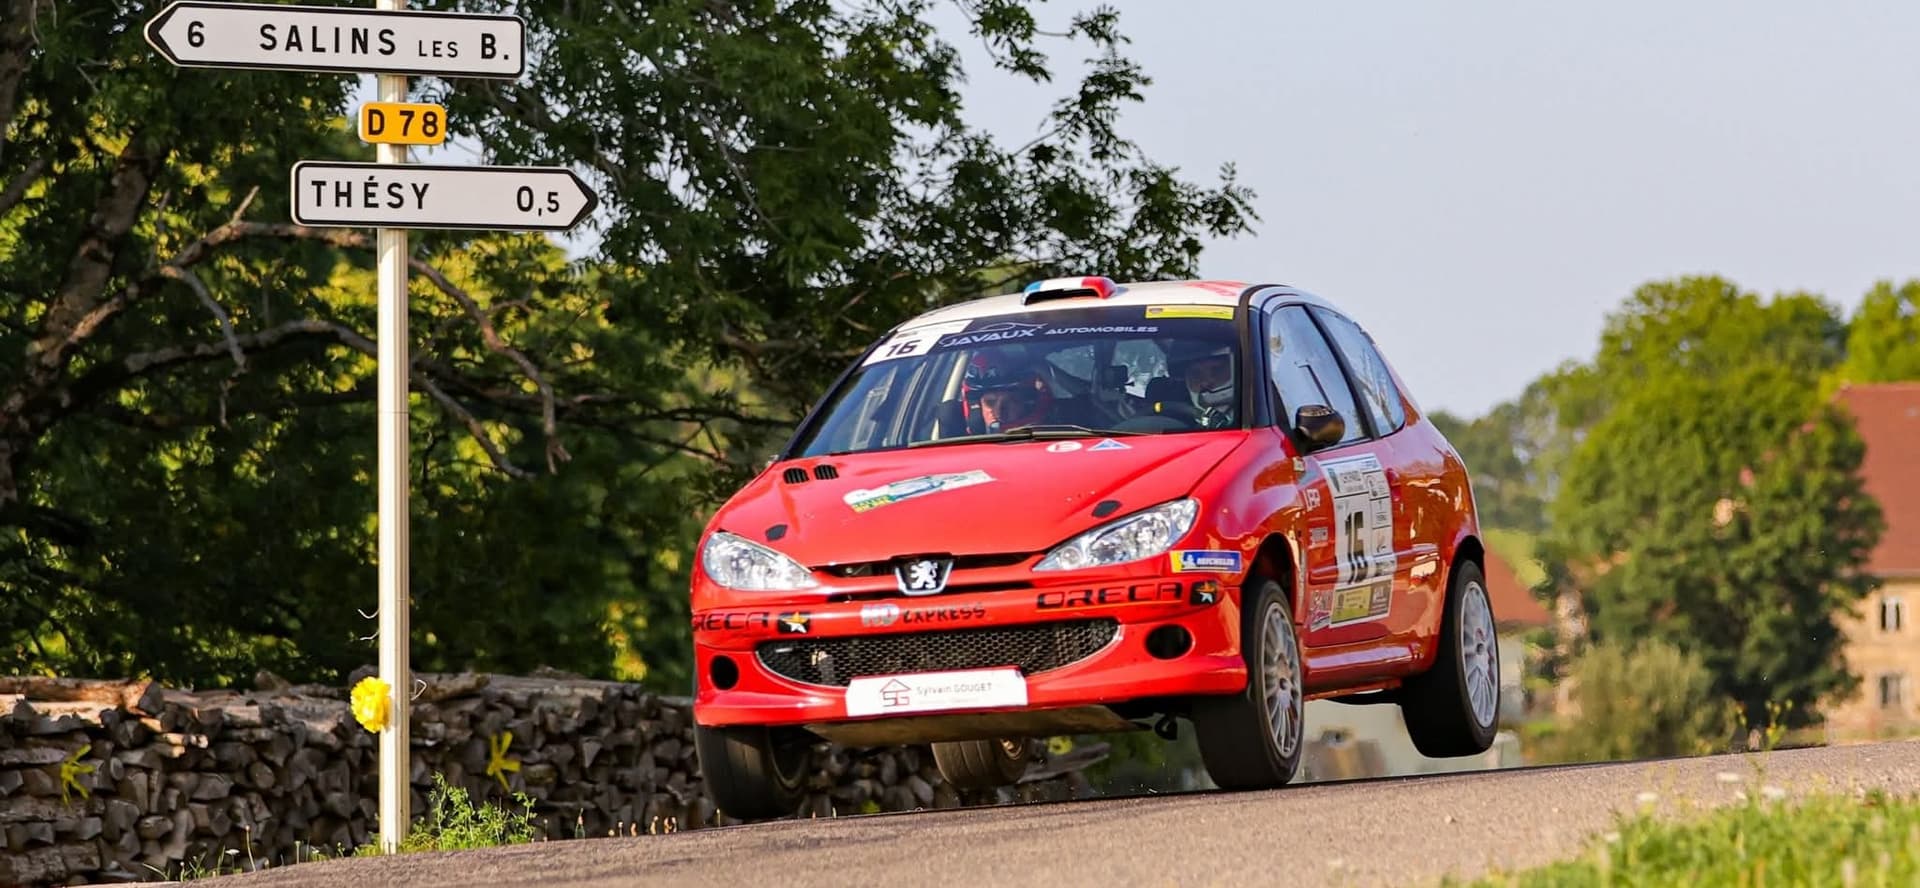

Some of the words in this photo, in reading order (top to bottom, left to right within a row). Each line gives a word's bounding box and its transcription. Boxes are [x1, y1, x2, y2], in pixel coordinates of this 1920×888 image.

[186, 21, 205, 48] 6
[259, 23, 397, 56] SALINS
[418, 40, 459, 59] LES
[480, 33, 510, 61] B.
[368, 109, 385, 136] D
[399, 110, 439, 137] 78
[311, 176, 430, 210] THÉSY
[516, 185, 560, 216] 0,5
[885, 339, 922, 358] 16
[941, 327, 1035, 347] JAVAUX
[1044, 326, 1159, 335] AUTOMOBILES
[1345, 511, 1369, 584] 16
[1037, 581, 1183, 608] ORECA
[903, 603, 986, 624] EXPRESS
